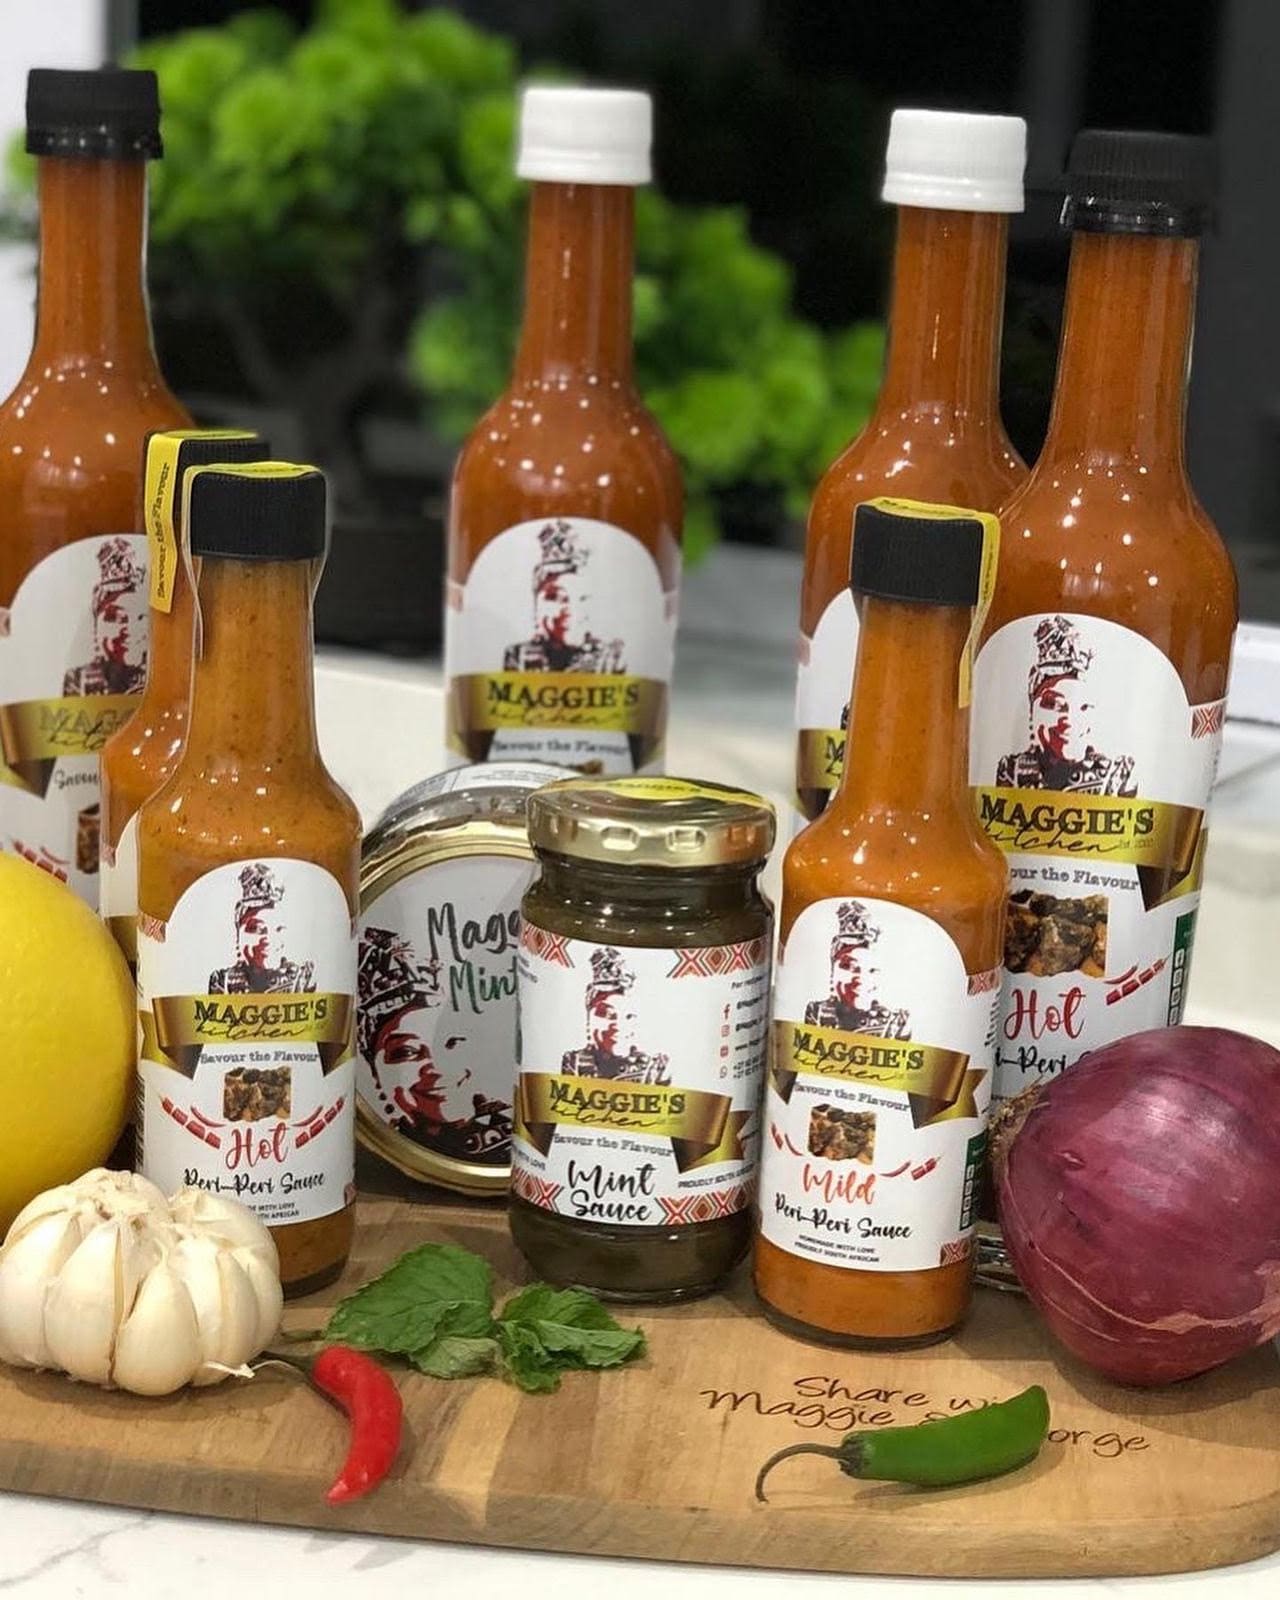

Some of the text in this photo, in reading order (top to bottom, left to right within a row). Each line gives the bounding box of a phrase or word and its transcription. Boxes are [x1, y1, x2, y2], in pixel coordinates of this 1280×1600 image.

[151, 462, 171, 599] Savour the Flavour
[488, 680, 640, 708] MAGGIE'S
[980, 794, 1154, 836] MAGGIE'S
[1010, 867, 1139, 891] our the Flavour
[194, 998, 328, 1026] MAGGIE'S
[196, 1010, 306, 1040] kitchen
[1004, 987, 1086, 1041] Hot
[200, 1051, 321, 1065] Savour the Flavour
[793, 1028, 924, 1070] MAGGIE'S
[793, 1046, 897, 1081] kitchen
[550, 1080, 686, 1114] MAGGIE'S
[551, 1098, 657, 1127] kitchen
[834, 1088, 857, 1101] the
[858, 1092, 911, 1112] Flavour
[225, 1122, 291, 1170] Hot
[597, 1136, 618, 1149] the
[620, 1139, 674, 1157] Flavour
[280, 1172, 325, 1194] Sauce
[568, 1160, 657, 1199] Mint
[803, 1163, 876, 1204] Mild
[570, 1189, 652, 1222] Sauce
[857, 1216, 912, 1239] Sauce
[793, 1376, 930, 1407] Share
[700, 1389, 895, 1431] Maggie
[1047, 1428, 1149, 1458] orge
